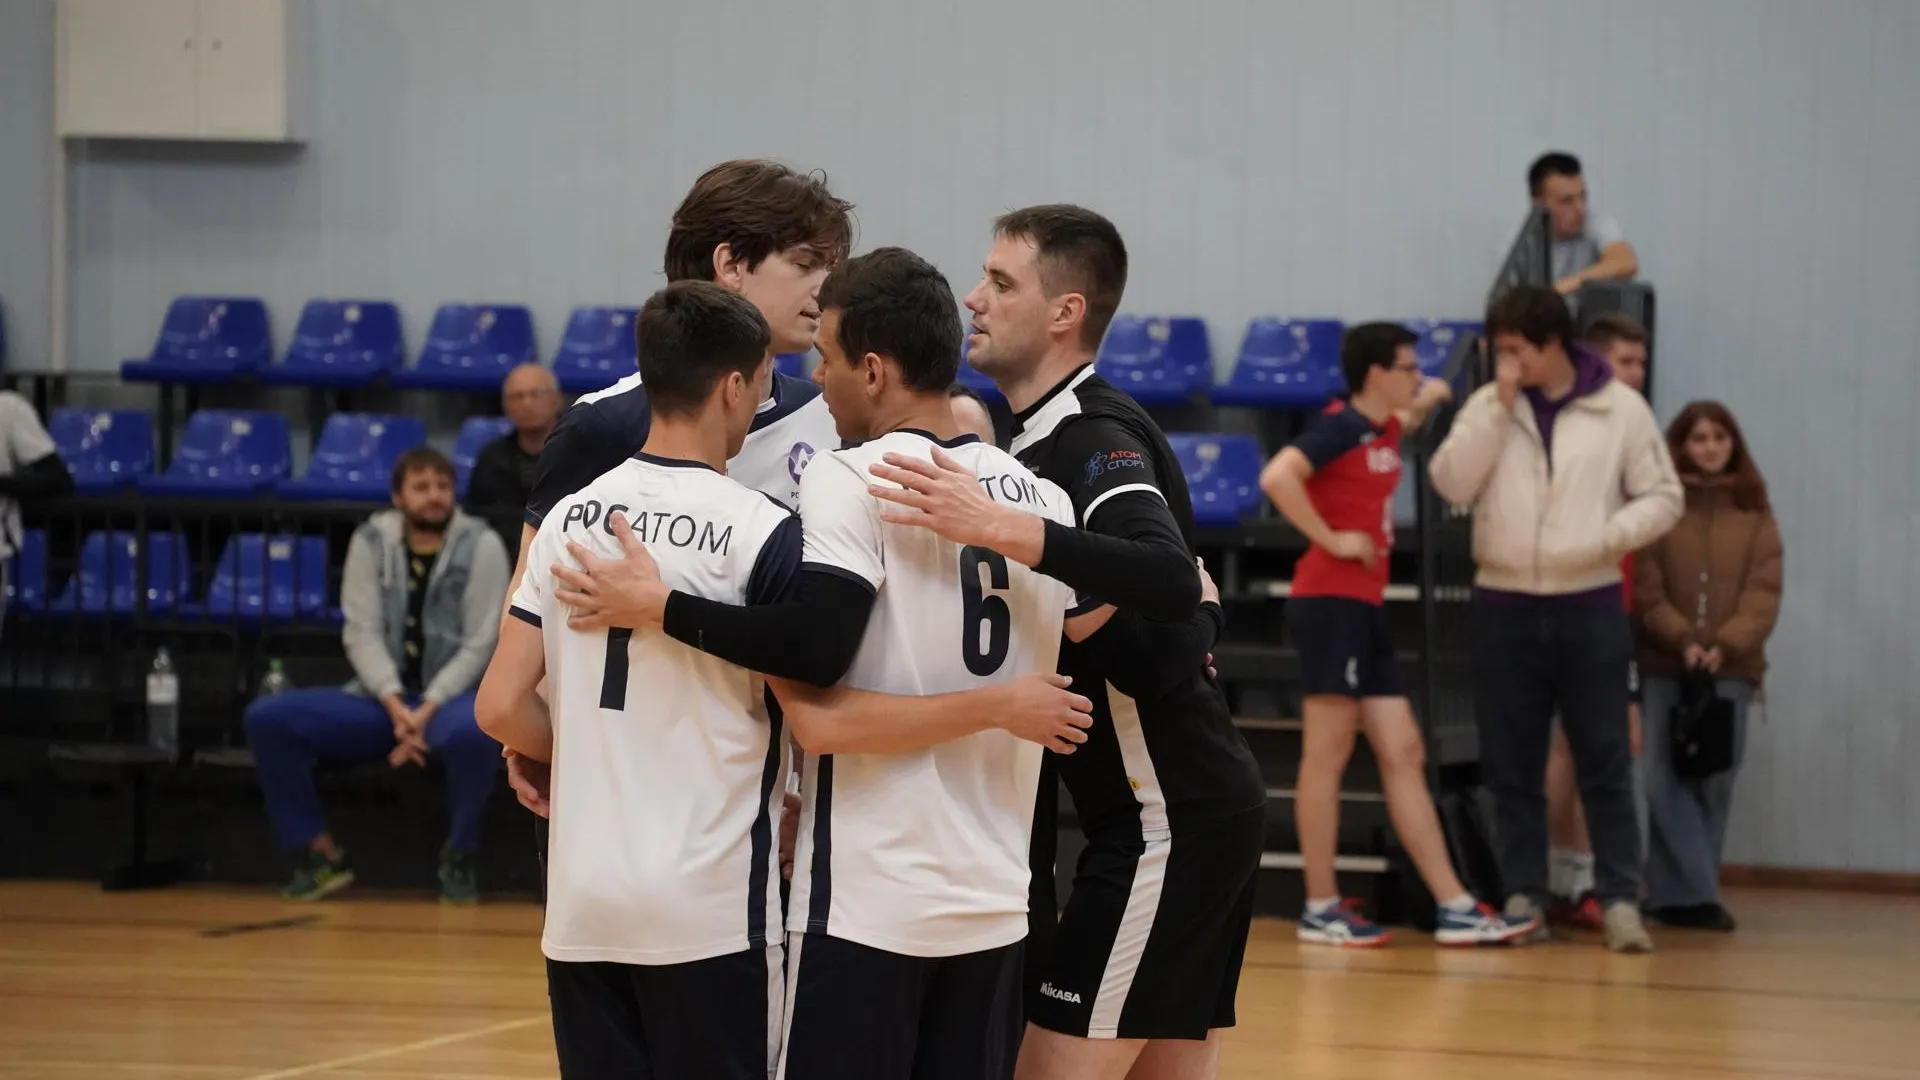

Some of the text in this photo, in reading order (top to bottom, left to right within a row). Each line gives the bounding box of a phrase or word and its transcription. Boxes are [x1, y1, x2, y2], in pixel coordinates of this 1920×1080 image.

[1110, 450, 1142, 460] АТОМ
[1107, 459, 1145, 470] СПОРТ
[960, 544, 1011, 677] 6
